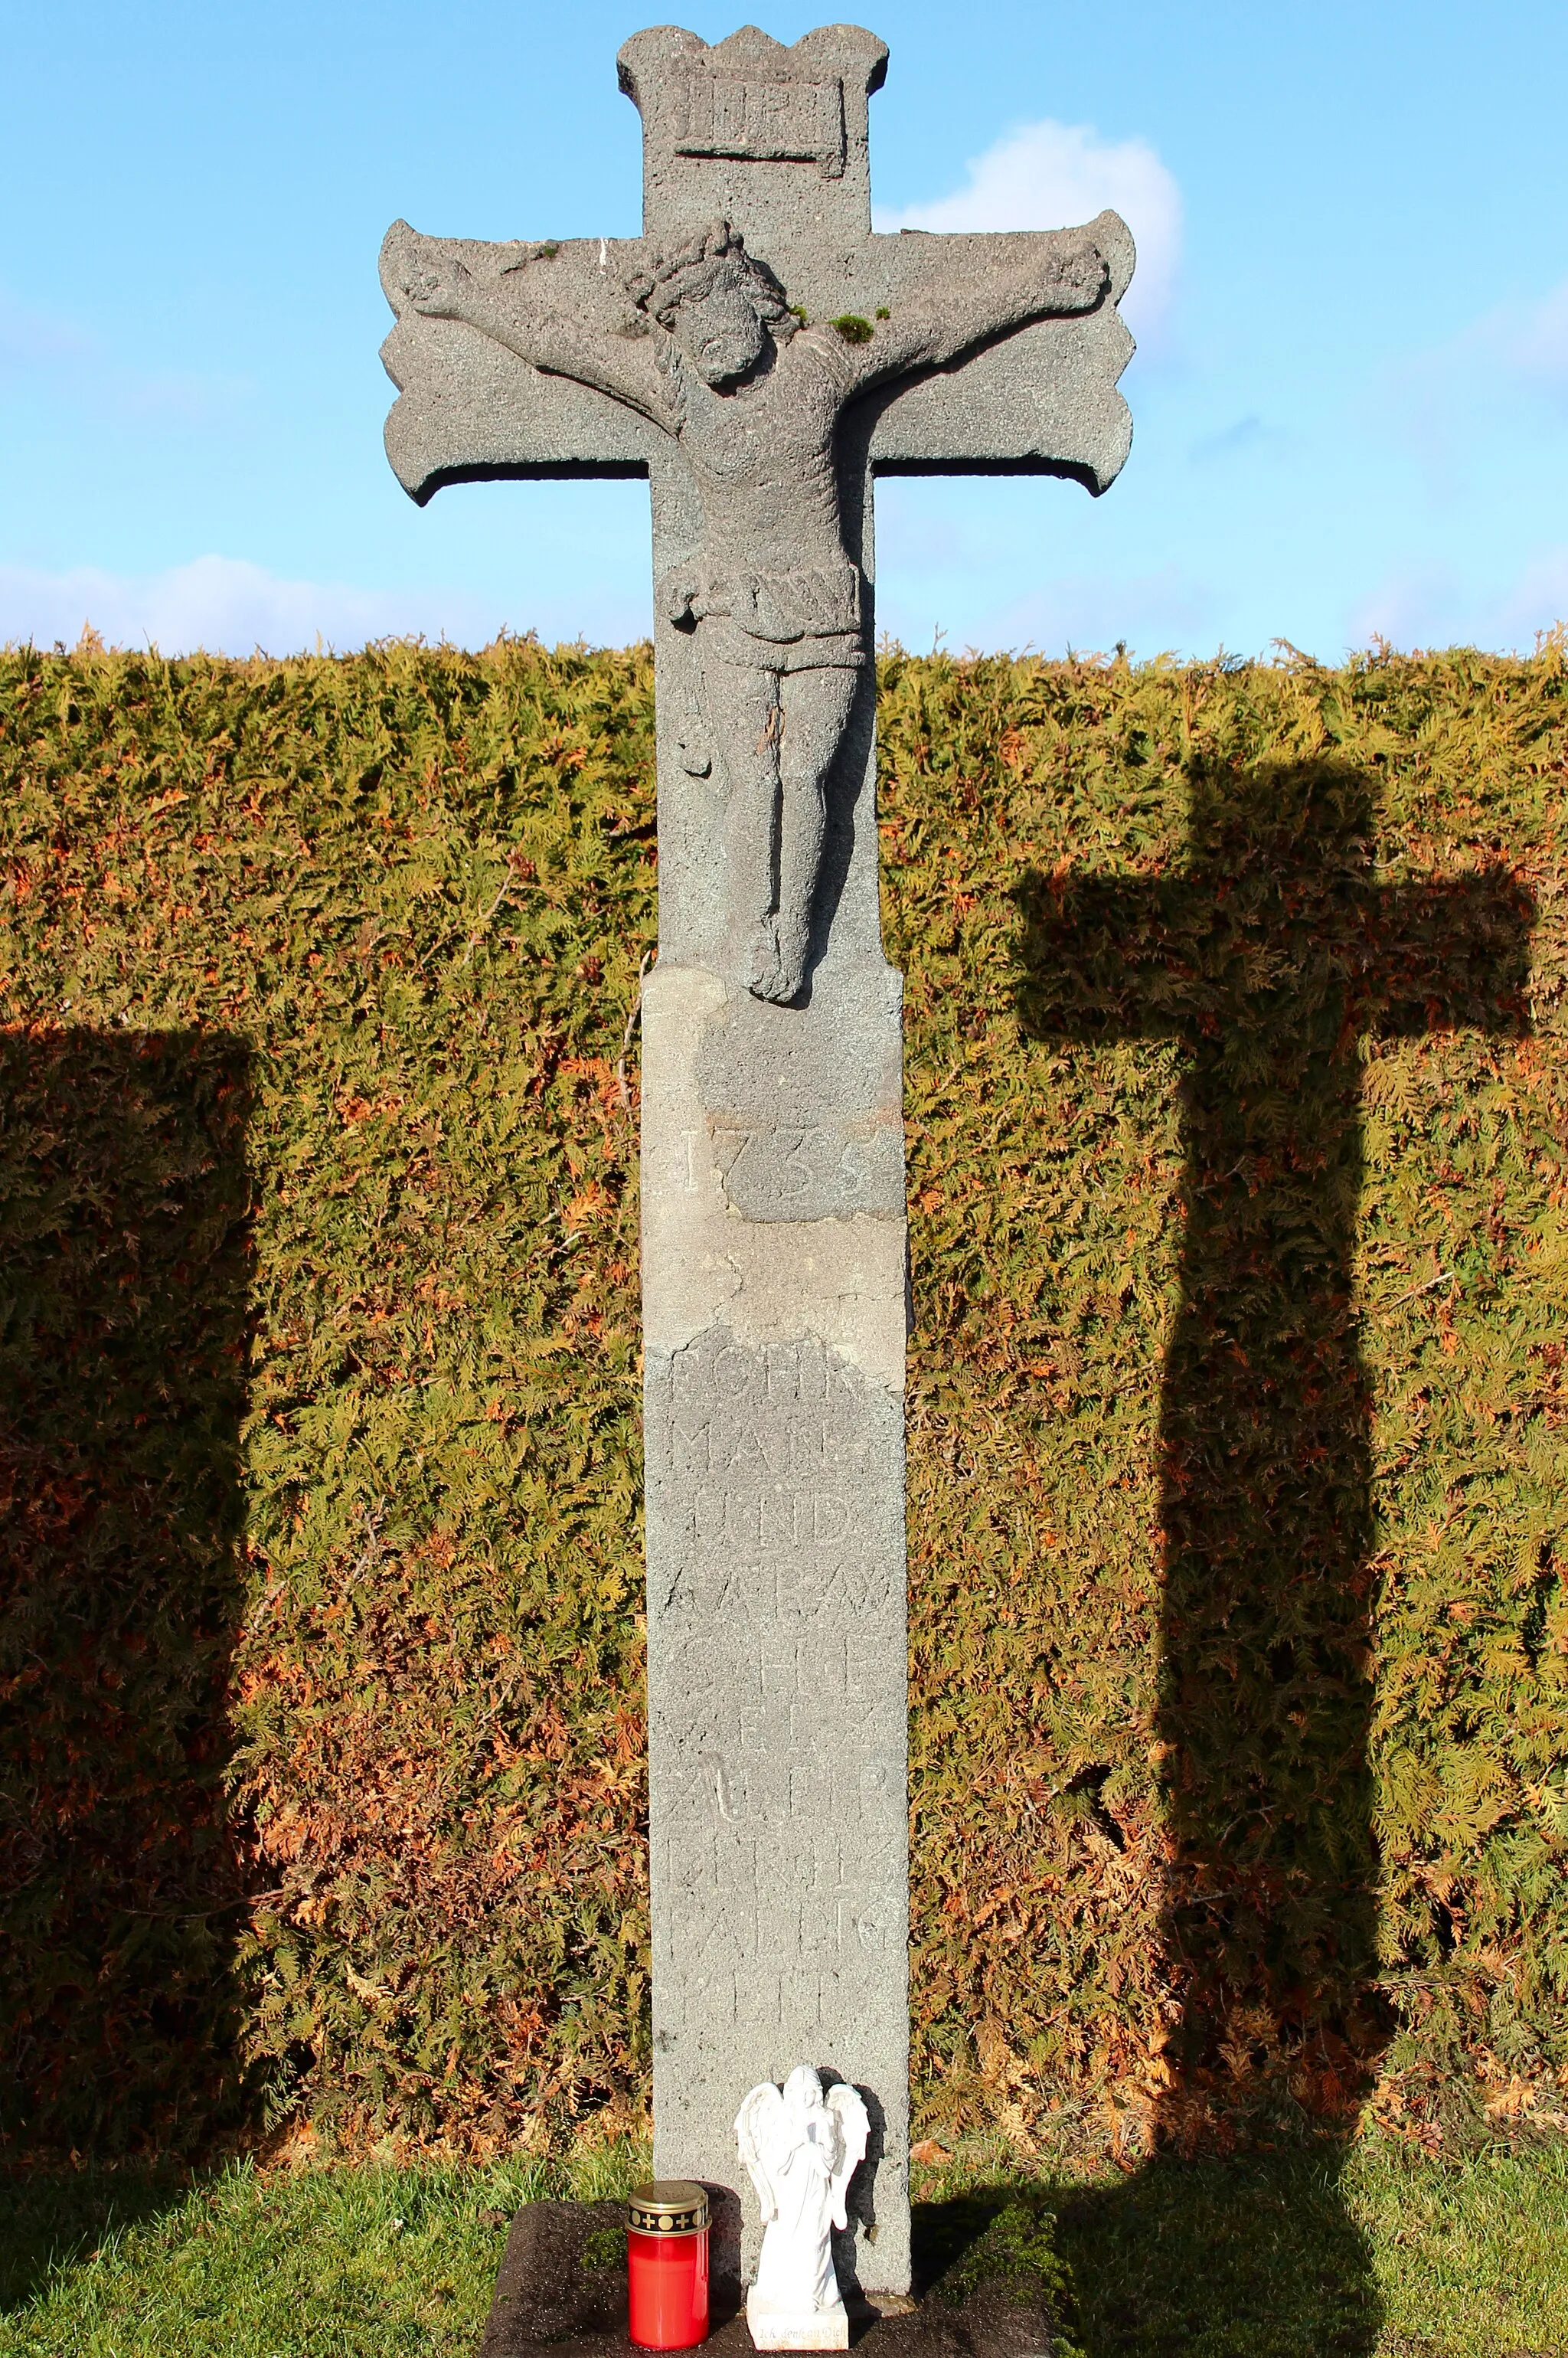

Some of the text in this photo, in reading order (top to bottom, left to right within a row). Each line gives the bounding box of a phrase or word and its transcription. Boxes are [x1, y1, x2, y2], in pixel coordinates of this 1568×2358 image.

[680, 1124, 880, 1200] 1735
[689, 1490, 850, 1549] UND
[759, 2325, 848, 2340] Ich denk an Dich
